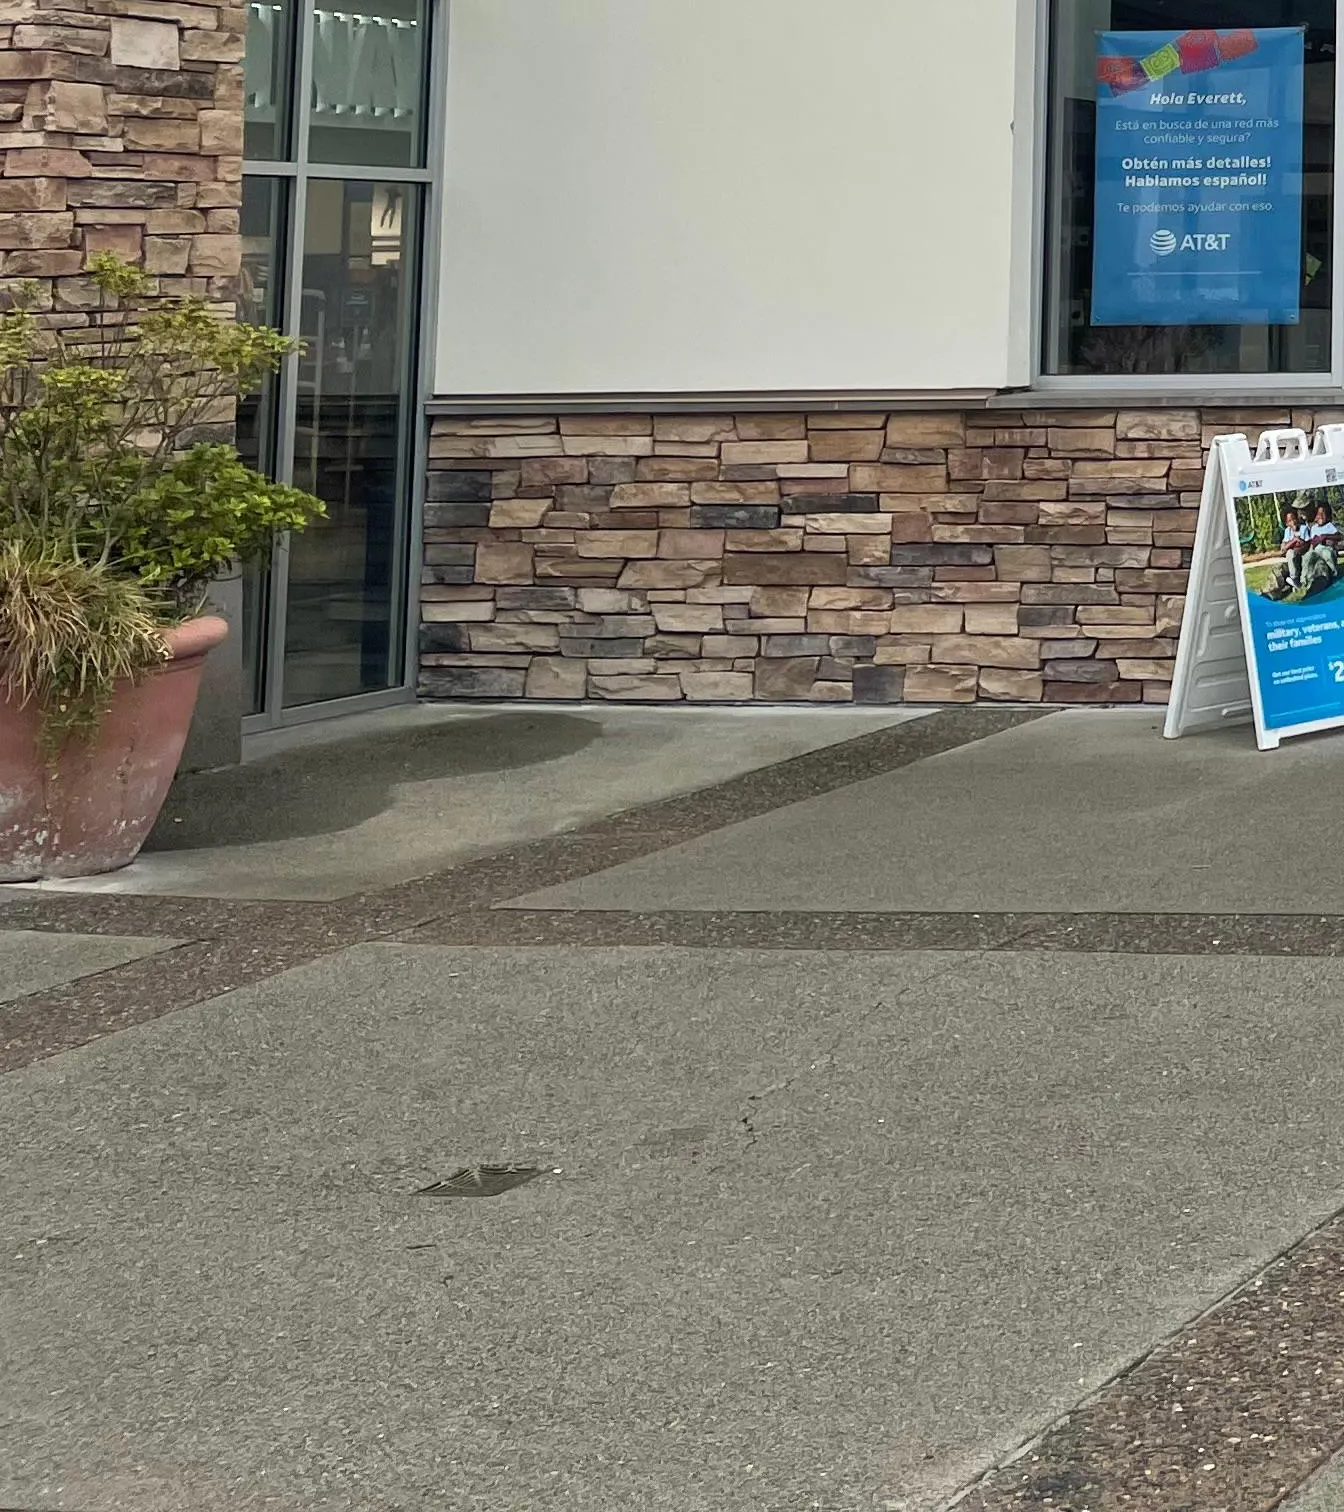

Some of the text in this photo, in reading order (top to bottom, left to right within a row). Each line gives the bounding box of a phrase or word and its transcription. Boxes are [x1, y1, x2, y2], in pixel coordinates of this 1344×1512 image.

[1150, 92, 1247, 106] Hola Everett,
[1115, 118, 1279, 130] Está en busca de una red más
[1144, 133, 1251, 145] confiable y segura?
[1122, 156, 1271, 170] Obtén más detalles!
[1125, 173, 1267, 188] Hablamos español!
[1117, 202, 1130, 213] Te
[1133, 202, 1185, 214] podemos
[1188, 201, 1225, 214] ayudar
[1229, 203, 1249, 212] con
[1179, 232, 1231, 251] AT&T
[1267, 628, 1301, 640] military,
[1268, 635, 1322, 652] their families
